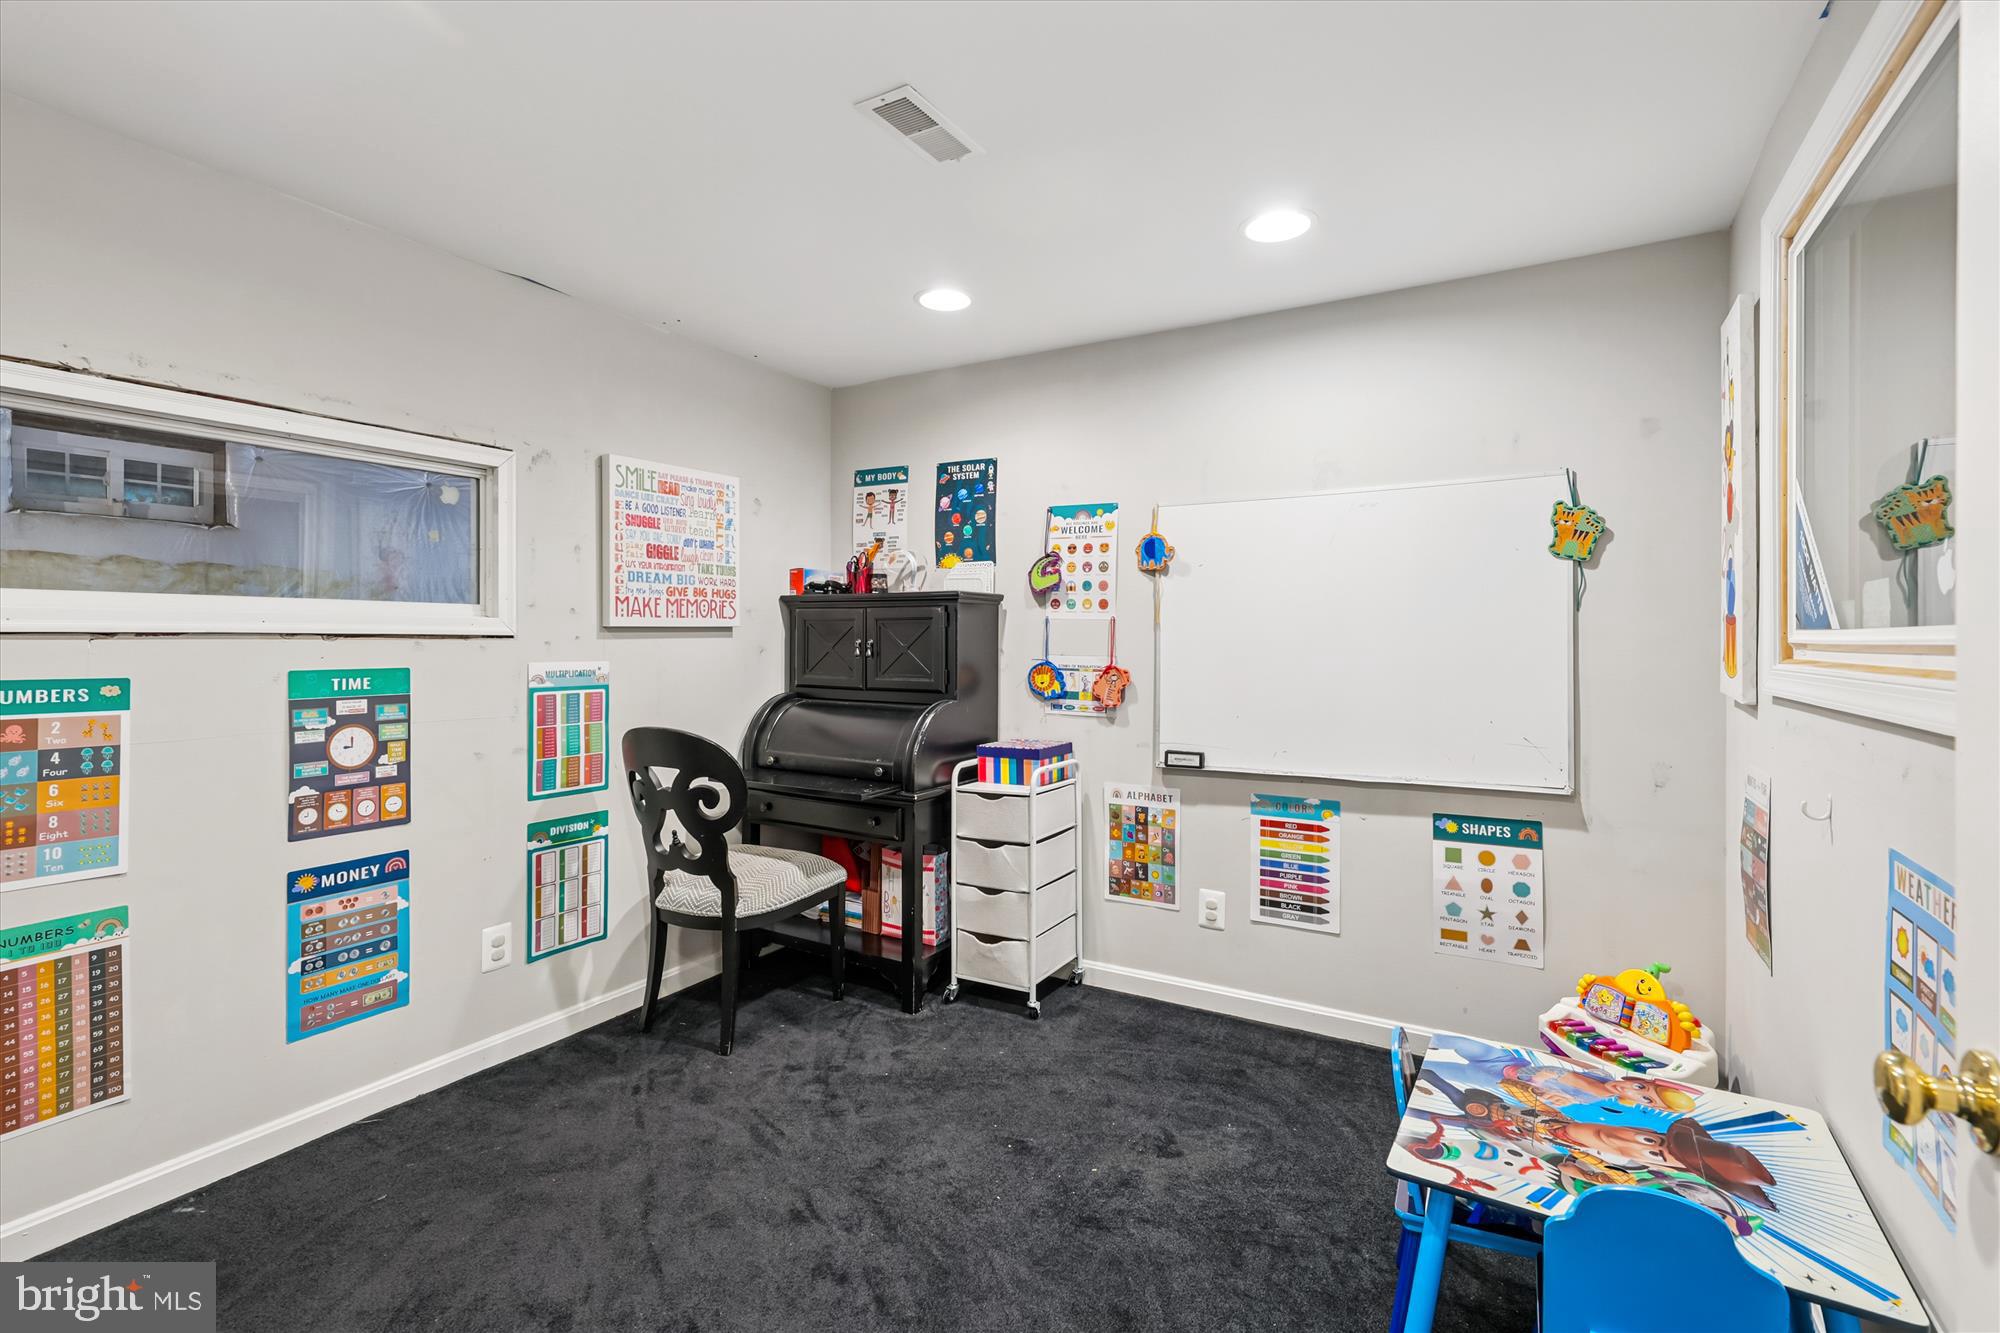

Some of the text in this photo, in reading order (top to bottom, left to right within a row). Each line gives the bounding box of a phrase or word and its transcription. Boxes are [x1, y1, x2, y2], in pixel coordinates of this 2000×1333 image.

[947, 463, 985, 474] THE SOLAR
[865, 472, 896, 482] MY BODY
[952, 471, 979, 480] SYSTEM
[625, 500, 686, 518] BE A GOOD LISTENER
[625, 513, 661, 530] SNUGGLE
[1061, 525, 1103, 534] WELCOME
[646, 543, 679, 560] GIGGLE
[627, 571, 695, 585] DREAM BIG
[698, 577, 736, 588] WORK HARD
[665, 586, 737, 599] GIVE BIG HUGS
[615, 595, 661, 618] MAKE
[545, 669, 596, 679] MULTIPLICATION
[331, 677, 371, 691] TIME
[51, 722, 61, 734] 2
[50, 752, 61, 765] 4
[42, 768, 68, 777] Four
[48, 784, 59, 796] 6
[1127, 791, 1173, 803] ALPHABET
[45, 800, 64, 808] Six
[1275, 802, 1315, 814] COLORS
[48, 816, 58, 828] 8
[550, 820, 589, 836] DIVISION
[39, 830, 69, 841] Eight
[1278, 832, 1304, 840] ORANGE
[1461, 822, 1511, 838] SHAPES
[43, 846, 62, 861] 10
[44, 864, 64, 873] Ten
[1283, 862, 1299, 870] BLUE
[321, 864, 380, 888] MONEY
[1279, 872, 1303, 880] PURPLE
[1279, 893, 1303, 901] BROWN
[1441, 890, 1466, 898] TRIANGLE
[1281, 903, 1301, 911] BLACK
[1440, 916, 1468, 924] PENTAGON
[1508, 925, 1536, 934] DIAMOND
[1440, 942, 1468, 950] RECTANGLE
[1507, 951, 1538, 961] TRAPEZOID
[3, 990, 13, 998] 14
[57, 977, 67, 985] 17
[92, 969, 101, 977] 19
[3, 1006, 15, 1014] 24
[57, 992, 69, 1000] 27
[92, 984, 102, 992] 29
[108, 980, 119, 988] 30
[4, 1022, 15, 1030] 34
[57, 1007, 69, 1016] 37
[57, 1023, 69, 1032] 47
[109, 1010, 119, 1018] 50
[4, 1025, 120, 1064] 54 57 59 60
[5, 1040, 120, 1080] 64 67 69 70
[5, 1087, 16, 1096] 74
[59, 1070, 70, 1079] 77
[93, 1060, 103, 1068] 79
[93, 1075, 103, 1083] 89
[5, 1085, 122, 1127] 94 97 99 100
